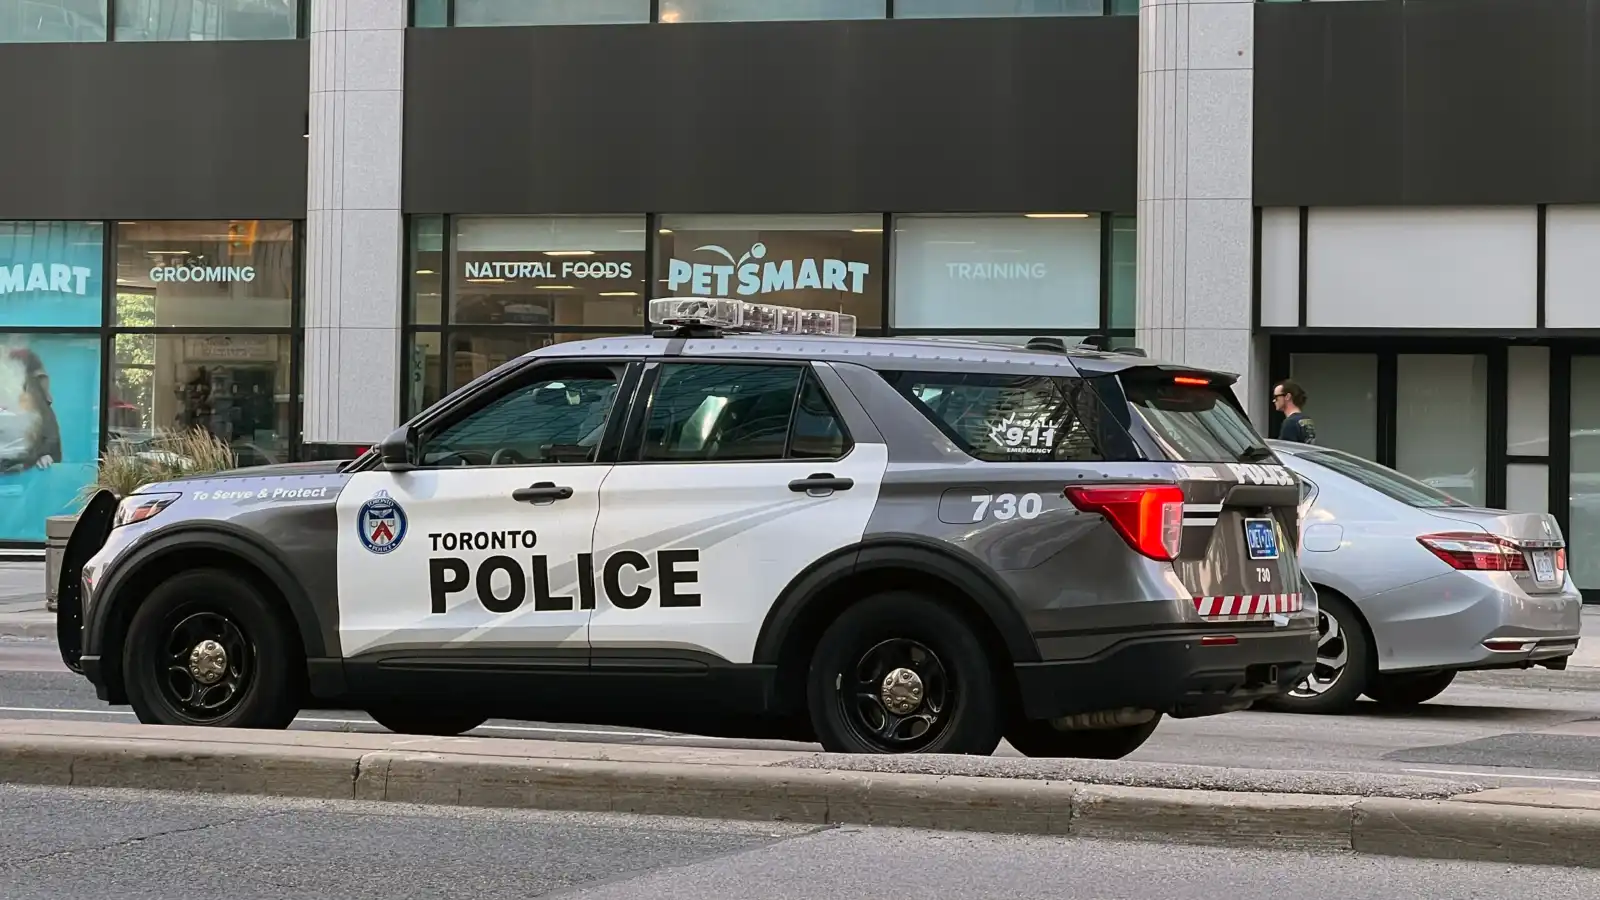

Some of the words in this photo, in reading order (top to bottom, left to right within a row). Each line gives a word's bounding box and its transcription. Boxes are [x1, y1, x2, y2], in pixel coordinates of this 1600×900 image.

[149, 265, 256, 282] GROOMING
[465, 261, 556, 279] NATURAL
[562, 261, 632, 279] FOODS
[946, 262, 1048, 280] TRAINING
[1224, 463, 1295, 486] POLICE
[192, 490, 208, 501] To
[212, 489, 252, 500] Serve
[256, 488, 268, 499] &
[272, 486, 327, 499] Protect
[971, 492, 1043, 521] 730
[428, 530, 537, 551] TORONTO
[428, 549, 702, 614] POLICE
[1256, 567, 1271, 583] 730
